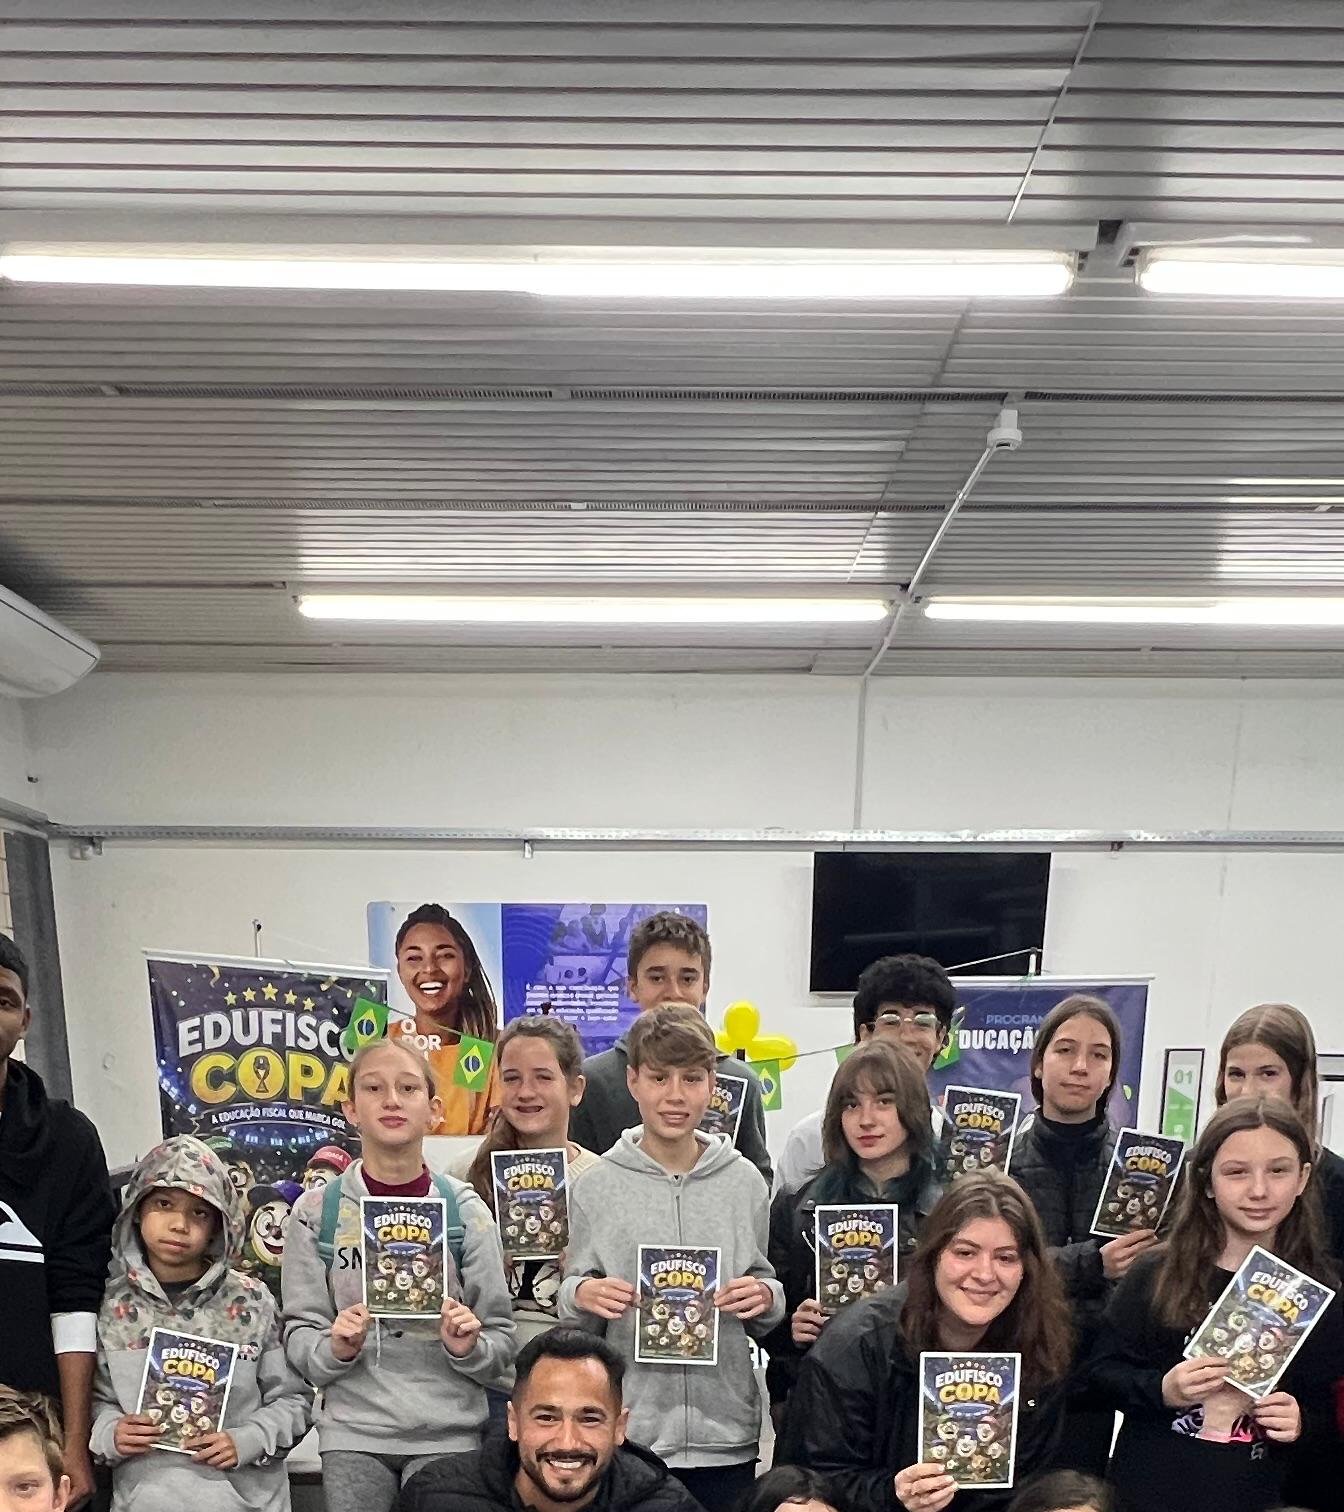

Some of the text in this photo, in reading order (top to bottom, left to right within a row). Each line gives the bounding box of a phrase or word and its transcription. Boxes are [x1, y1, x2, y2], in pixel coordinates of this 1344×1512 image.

[986, 1014, 1043, 1025] PROGRA
[955, 1025, 1039, 1054] DUCAÇÃ
[190, 1047, 352, 1105] COPA
[1174, 1069, 1194, 1085] 01
[262, 1107, 287, 1118] FISCAL
[288, 1108, 304, 1120] QUE
[954, 1103, 1005, 1121] EDUFISCO
[955, 1113, 1001, 1133] COPA
[1125, 1145, 1172, 1164] EDUFISCO
[503, 1163, 555, 1180] EDUFISCO
[1125, 1156, 1167, 1176] COPA
[507, 1175, 555, 1190] COPA
[373, 1211, 433, 1230] EDUFISCO
[827, 1219, 884, 1236] EDUFISCO
[377, 1225, 431, 1244] COPA
[831, 1232, 881, 1248] COPA
[650, 1259, 707, 1276] EDUFISCO
[653, 1271, 705, 1290] COPA
[161, 1347, 220, 1370] EDUFISCO
[163, 1359, 216, 1384] COPA
[935, 1369, 1003, 1388] EDUFISCO
[939, 1383, 1001, 1405] COPA
